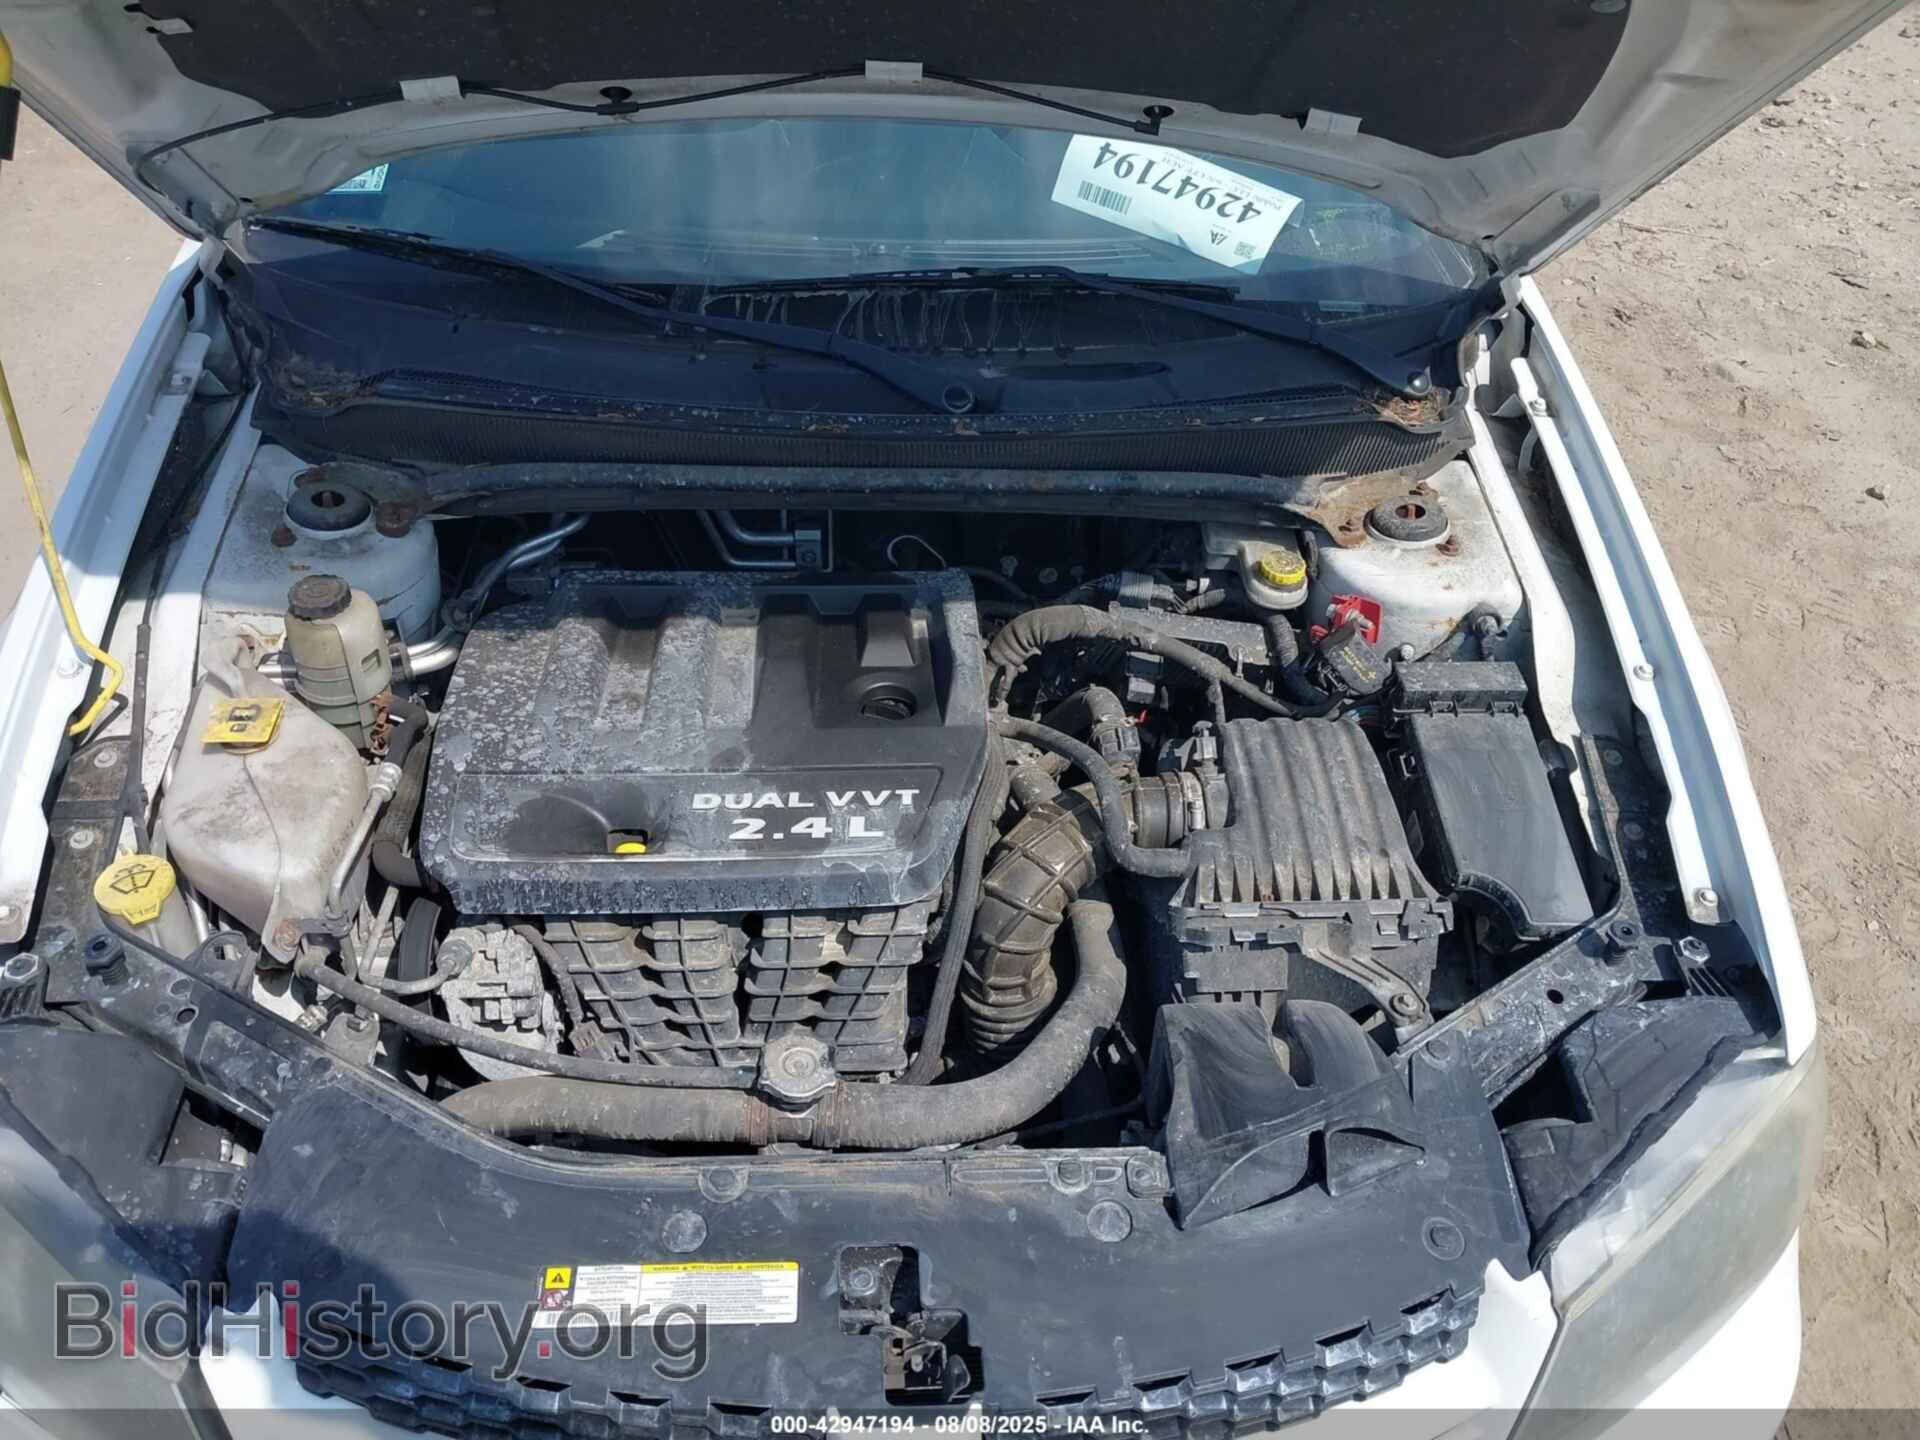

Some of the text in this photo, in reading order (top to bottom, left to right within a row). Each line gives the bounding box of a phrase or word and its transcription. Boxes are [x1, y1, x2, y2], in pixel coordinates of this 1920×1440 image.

[1093, 141, 1261, 224] 42947194
[691, 789, 920, 809] DUAL VVT
